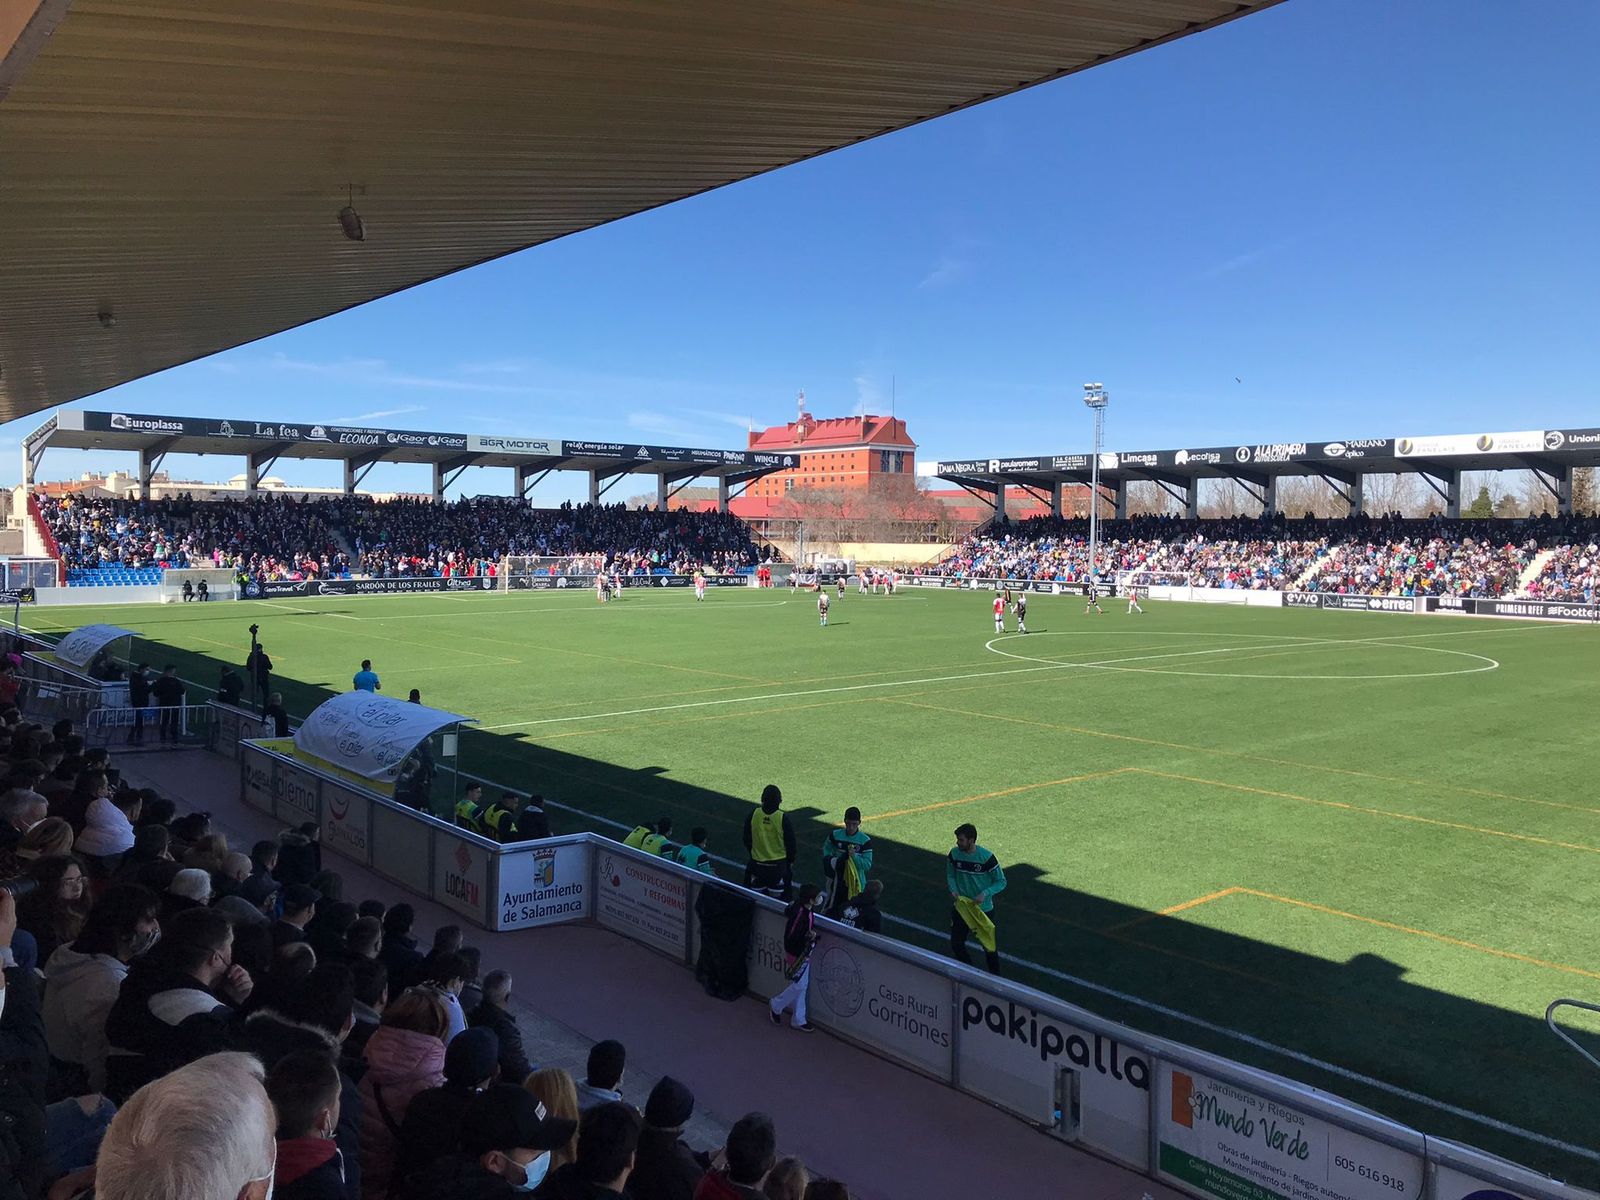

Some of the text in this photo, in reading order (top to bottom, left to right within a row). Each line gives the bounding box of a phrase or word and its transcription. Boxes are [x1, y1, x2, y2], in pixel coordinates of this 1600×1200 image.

[125, 417, 183, 431] Europlassa
[254, 423, 299, 437] La fea
[339, 433, 379, 445] ECONOA
[506, 440, 550, 452] MOTOR
[1345, 439, 1387, 449] MARIANO
[1121, 453, 1158, 464] Limcasa
[1191, 452, 1221, 461] ecofisa
[355, 582, 384, 590] SARDÓN
[413, 580, 441, 588] FRAILES
[1495, 603, 1527, 615] PRIMERA
[625, 866, 686, 897] CONSTRUCCIONES
[503, 883, 583, 909] Ayuntamiento
[649, 889, 686, 912] REFORMAS
[503, 909, 518, 923] de
[521, 900, 583, 920] Salamanca
[878, 983, 939, 1021] Casa Rural
[868, 997, 950, 1049] Gorriones
[962, 996, 1150, 1092] pakipalla
[1258, 1102, 1265, 1112] y
[1267, 1101, 1305, 1127] Riegos
[1197, 1093, 1310, 1161] Mundo Verde
[1217, 1142, 1239, 1157] Obras
[1240, 1151, 1250, 1161] de
[1292, 1173, 1319, 1192] Riegos
[1222, 1156, 1280, 1187] Mantenimiento
[1281, 1182, 1291, 1191] de
[1334, 1155, 1405, 1193] 605 616 918
